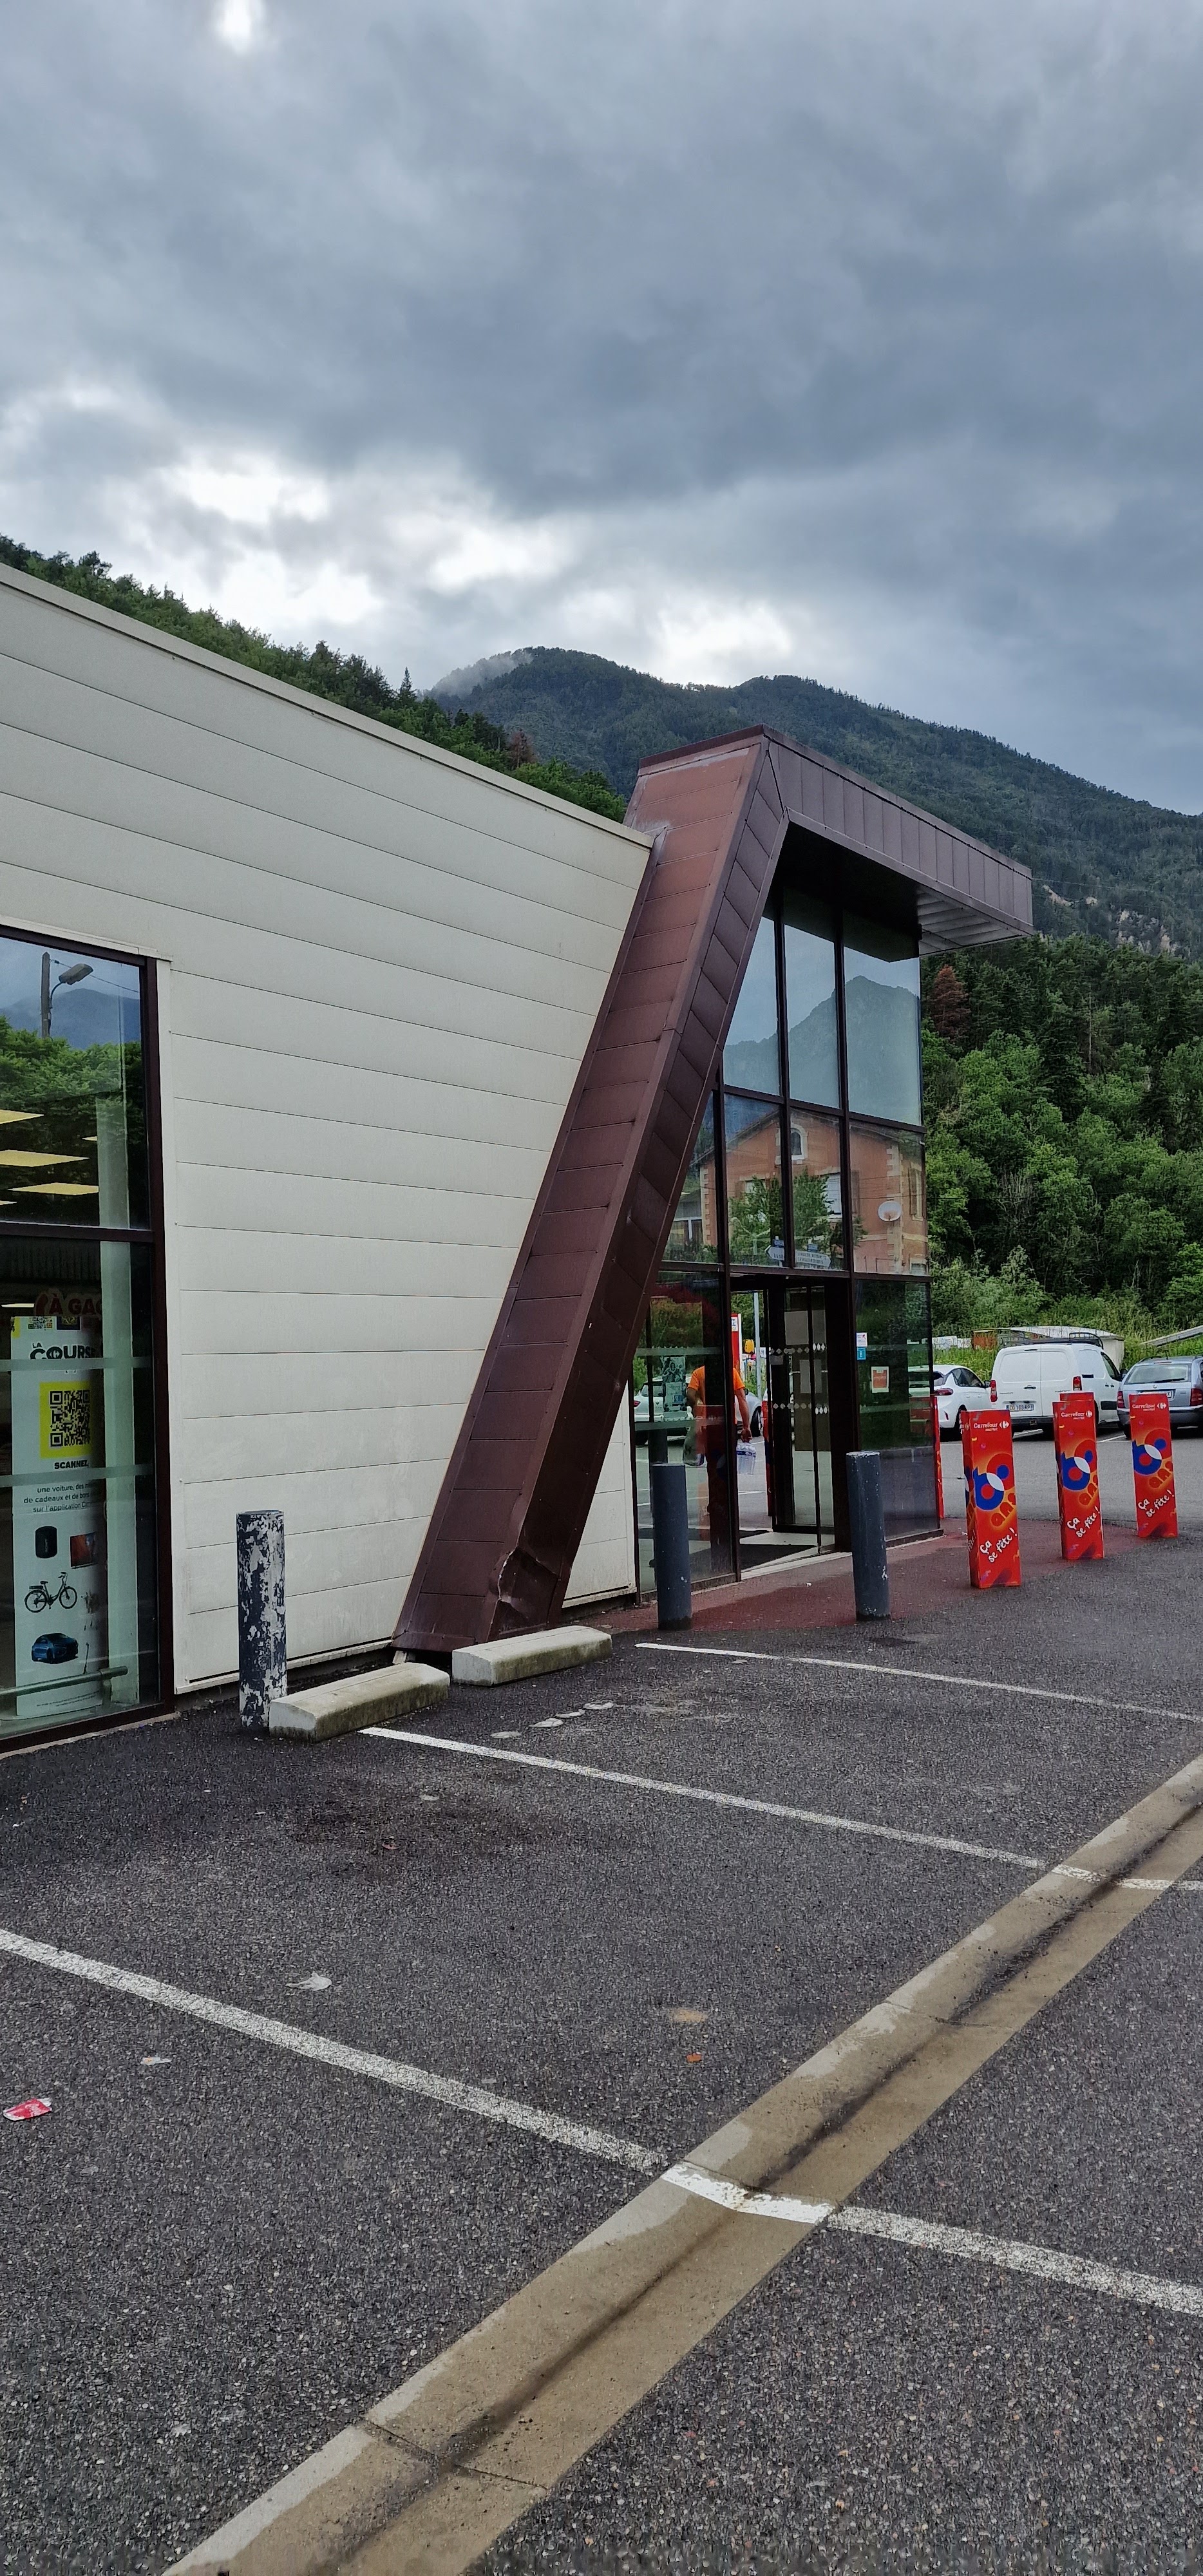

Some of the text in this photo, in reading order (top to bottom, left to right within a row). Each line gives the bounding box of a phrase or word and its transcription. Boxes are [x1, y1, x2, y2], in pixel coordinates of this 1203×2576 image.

[1137, 1499, 1150, 1511] Ça
[1146, 1508, 1155, 1517] se
[1066, 1517, 1081, 1531] Ça
[1075, 1528, 1086, 1538] se
[980, 1540, 992, 1555] Ça
[989, 1551, 998, 1563] se
